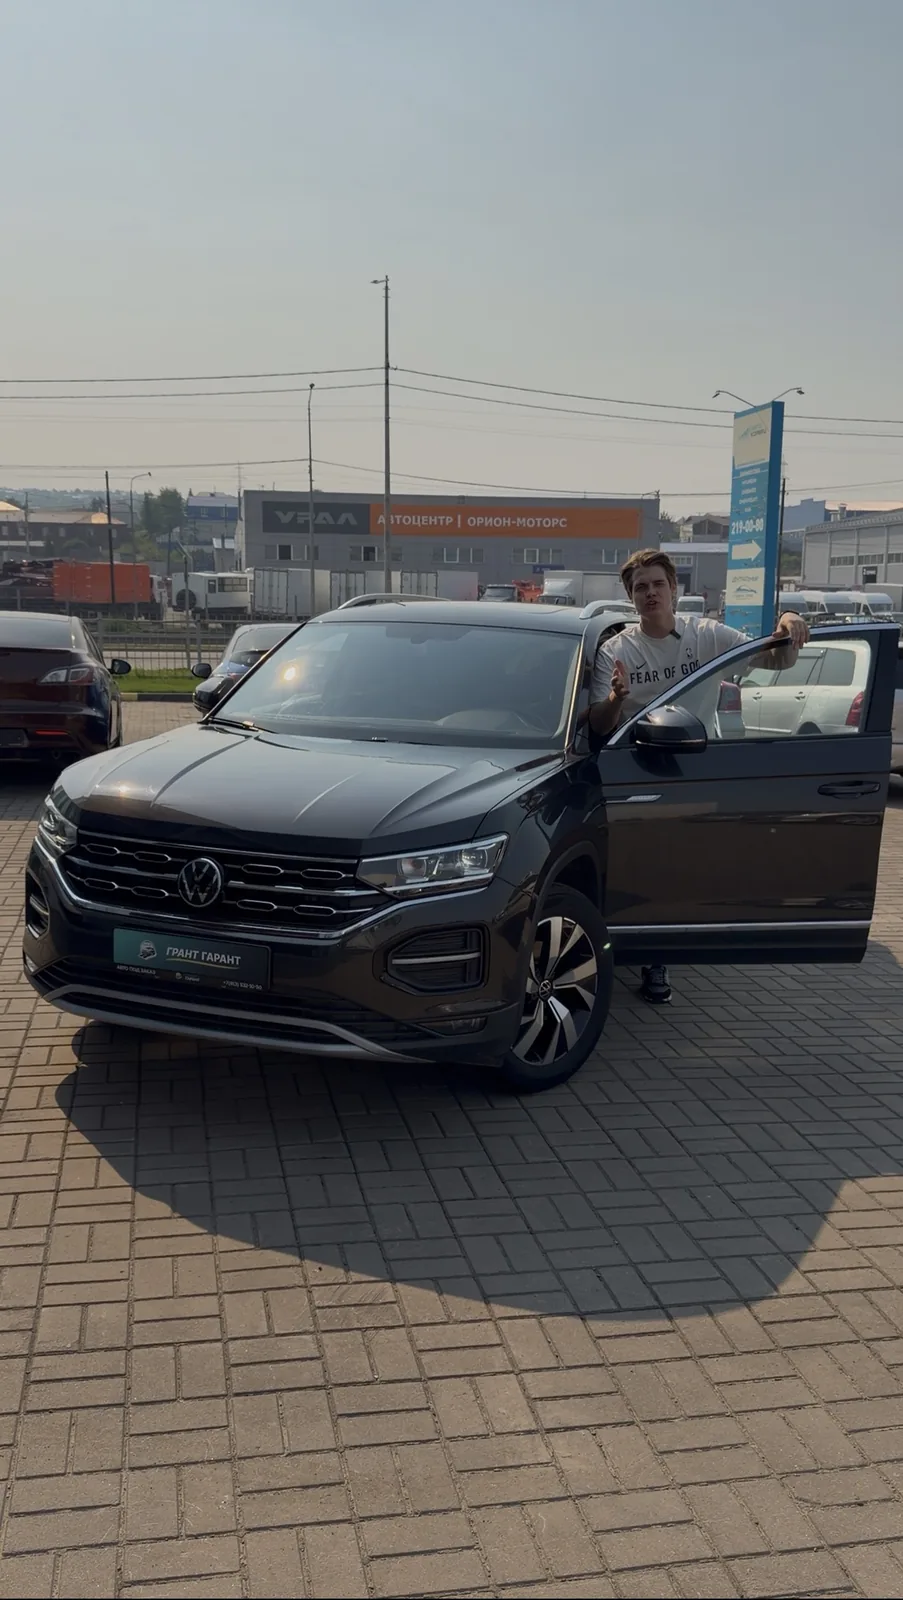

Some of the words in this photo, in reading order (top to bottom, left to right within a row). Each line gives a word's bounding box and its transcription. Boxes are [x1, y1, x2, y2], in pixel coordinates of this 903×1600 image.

[274, 510, 358, 526] УРАЛ
[467, 516, 567, 528] ОРИОН-МОТОРС
[630, 670, 660, 684] FEAR
[664, 666, 676, 679] OF
[166, 946, 199, 960] ГРАНТ
[201, 951, 241, 965] ГАРАНТ
